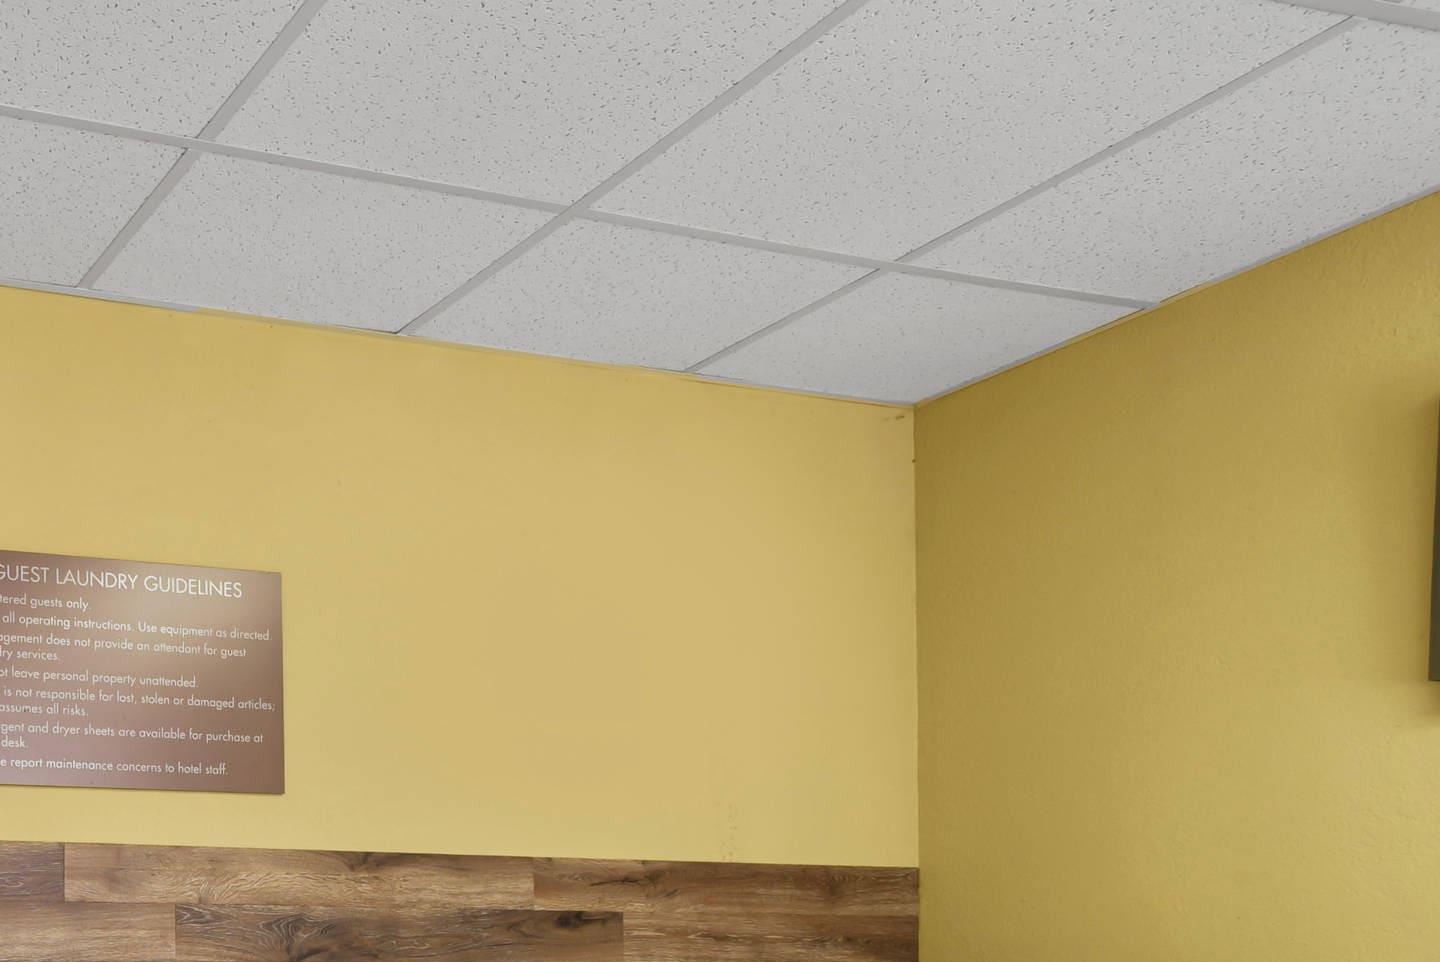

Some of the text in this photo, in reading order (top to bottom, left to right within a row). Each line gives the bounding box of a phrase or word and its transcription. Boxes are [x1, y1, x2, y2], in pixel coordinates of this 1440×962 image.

[55, 569, 138, 589] LAUNDRY
[144, 575, 243, 599] GUIDELINES
[30, 596, 63, 609] guests
[2, 612, 16, 624] all
[18, 614, 71, 630] operating
[138, 621, 157, 633] Use
[160, 624, 212, 639] equipment
[216, 628, 228, 638] as
[46, 633, 71, 646] does
[74, 636, 90, 647] not
[94, 637, 133, 651] provide
[136, 640, 150, 650] an
[153, 640, 200, 654] attendant
[203, 642, 217, 655] for
[220, 644, 247, 658] guest
[11, 666, 40, 680] leave
[43, 669, 89, 684] personal
[92, 672, 136, 688] property
[3, 686, 12, 697] is
[15, 688, 32, 698] not
[35, 686, 95, 702] responsible
[99, 690, 113, 701] for
[141, 692, 170, 704] stolen
[173, 695, 184, 705] or
[187, 694, 235, 710] damaged
[46, 703, 59, 715] all
[27, 721, 49, 733] and
[52, 723, 81, 737] dryer
[84, 724, 114, 736] sheets
[118, 727, 136, 737] are
[139, 726, 186, 740] available
[189, 728, 203, 741] for
[206, 730, 250, 744] purchase
[253, 733, 263, 743] at
[10, 757, 43, 769] report
[46, 757, 113, 771] maintenance
[116, 760, 162, 773] concerns
[165, 762, 175, 773] to
[178, 761, 202, 774] hotel
